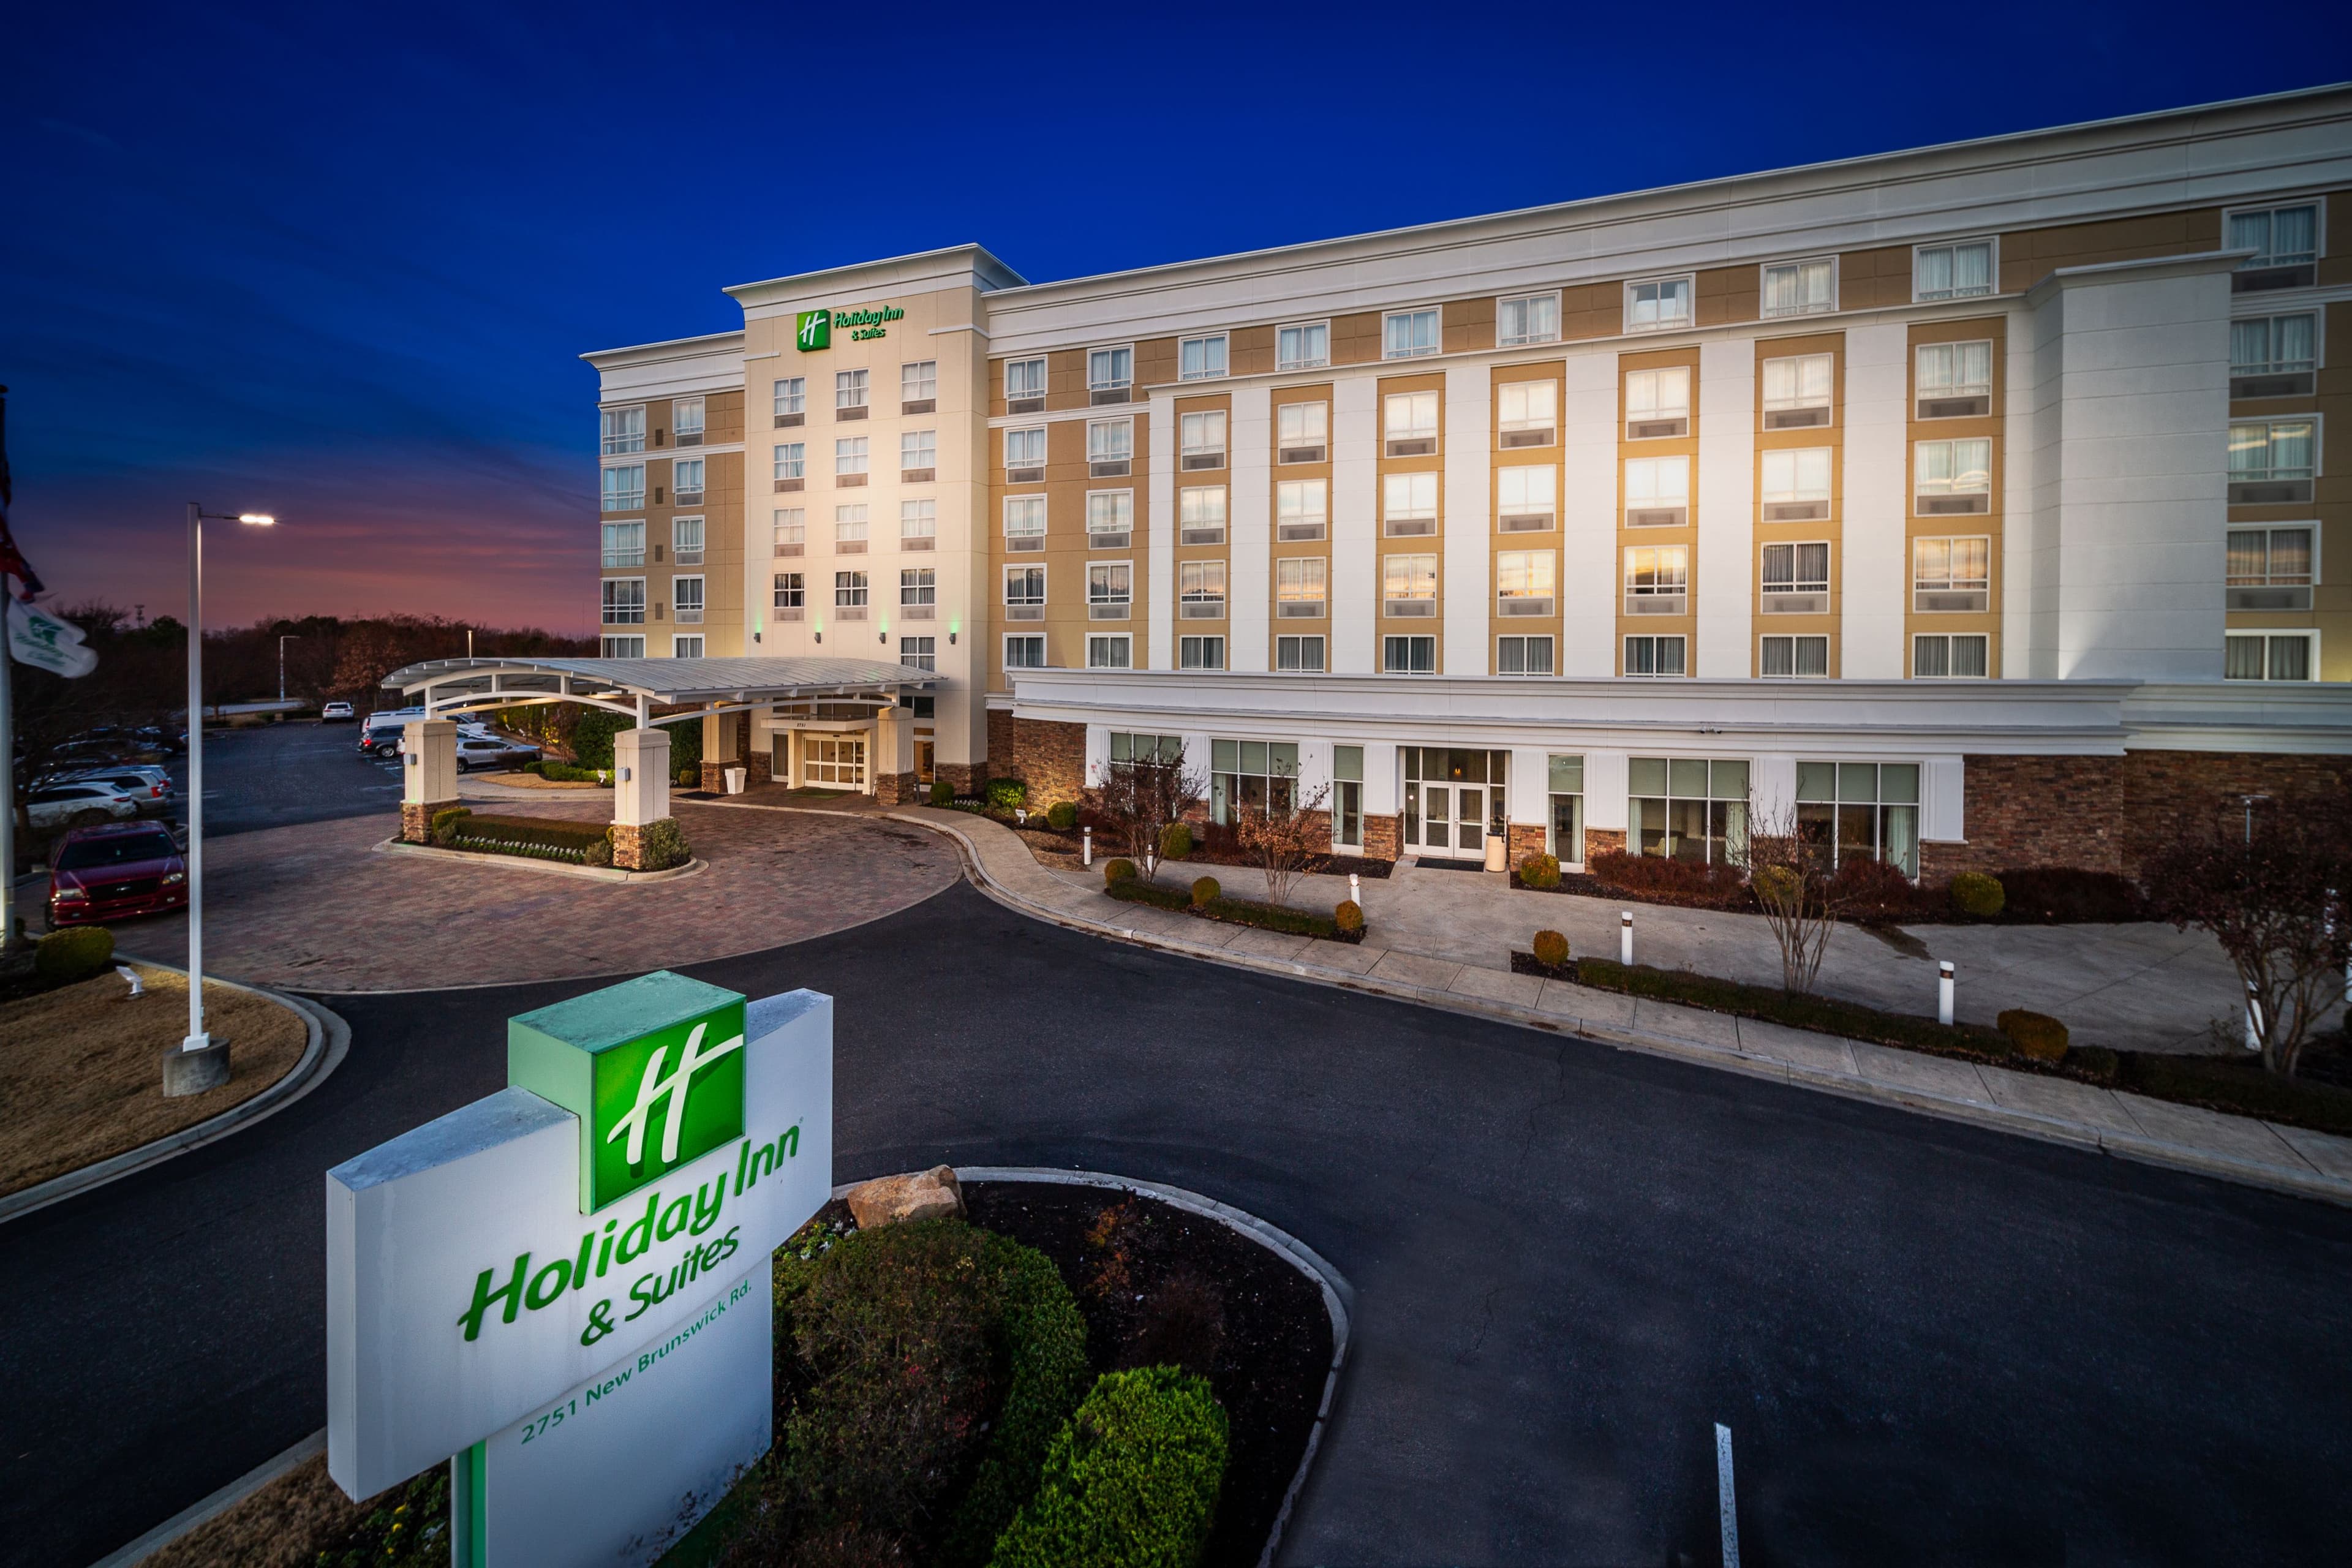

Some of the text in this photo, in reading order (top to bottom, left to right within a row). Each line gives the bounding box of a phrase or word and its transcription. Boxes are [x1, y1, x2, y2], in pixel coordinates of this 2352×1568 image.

[834, 305, 904, 328] Holiday Inn
[851, 328, 886, 341] & Suites
[458, 1125, 800, 1341] Holiday Inn
[581, 1226, 740, 1346] & Suites
[521, 1279, 752, 1446] 2751 New Brunswick Rd.
